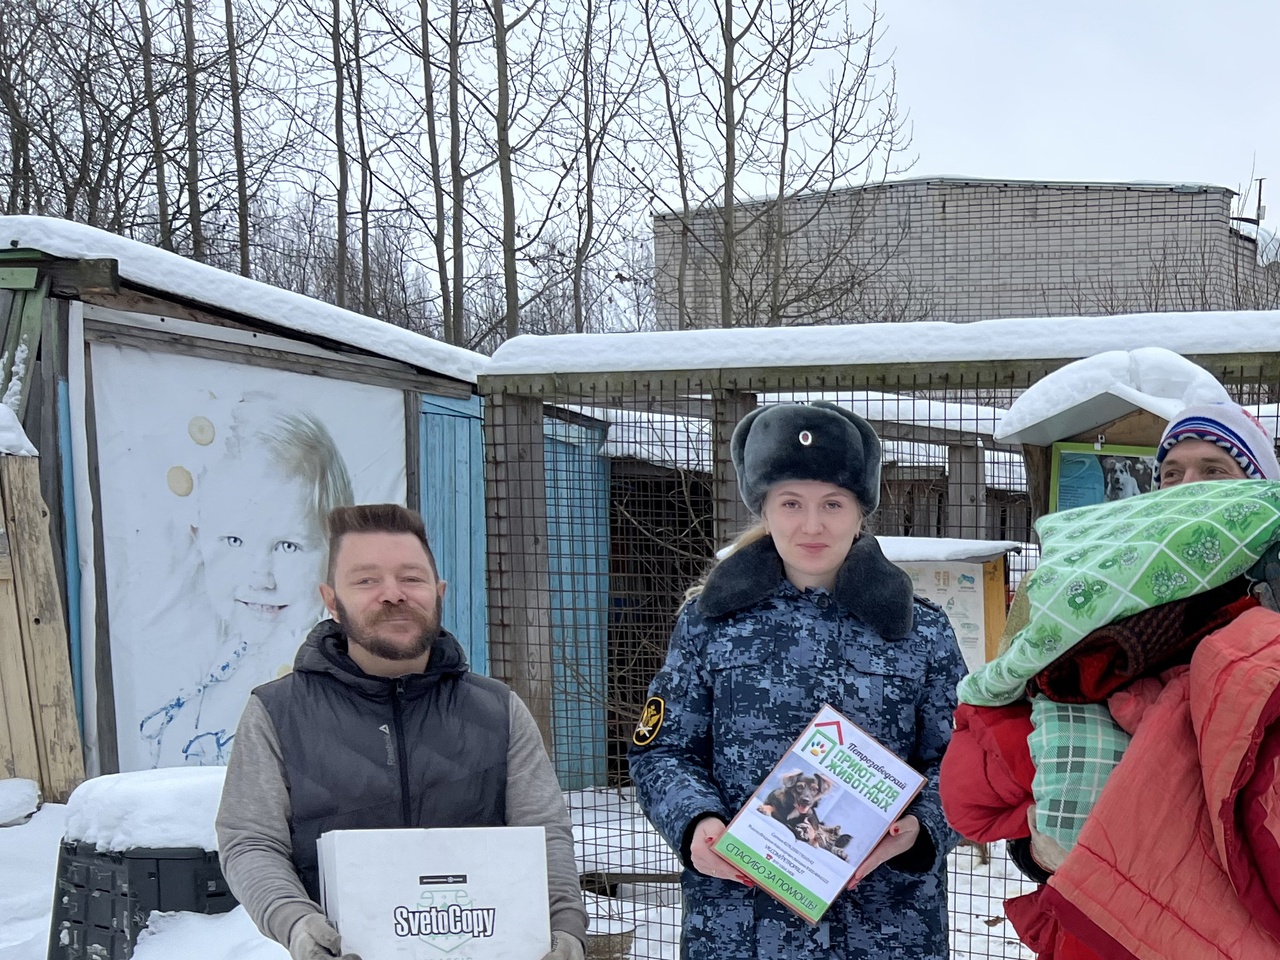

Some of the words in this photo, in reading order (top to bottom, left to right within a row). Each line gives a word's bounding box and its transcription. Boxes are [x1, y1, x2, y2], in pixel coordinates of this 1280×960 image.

[824, 759, 893, 813] ЖИВОТНЫХ
[833, 748, 876, 784] ПРИЮТ
[872, 778, 901, 803] ДЛЯ
[847, 741, 908, 791] Петрозаводский
[725, 841, 768, 876] СПАСИБО
[763, 869, 779, 885] ЗА
[775, 877, 819, 913] ПОМОЩЬ!
[394, 904, 496, 938] SvetoCopy
